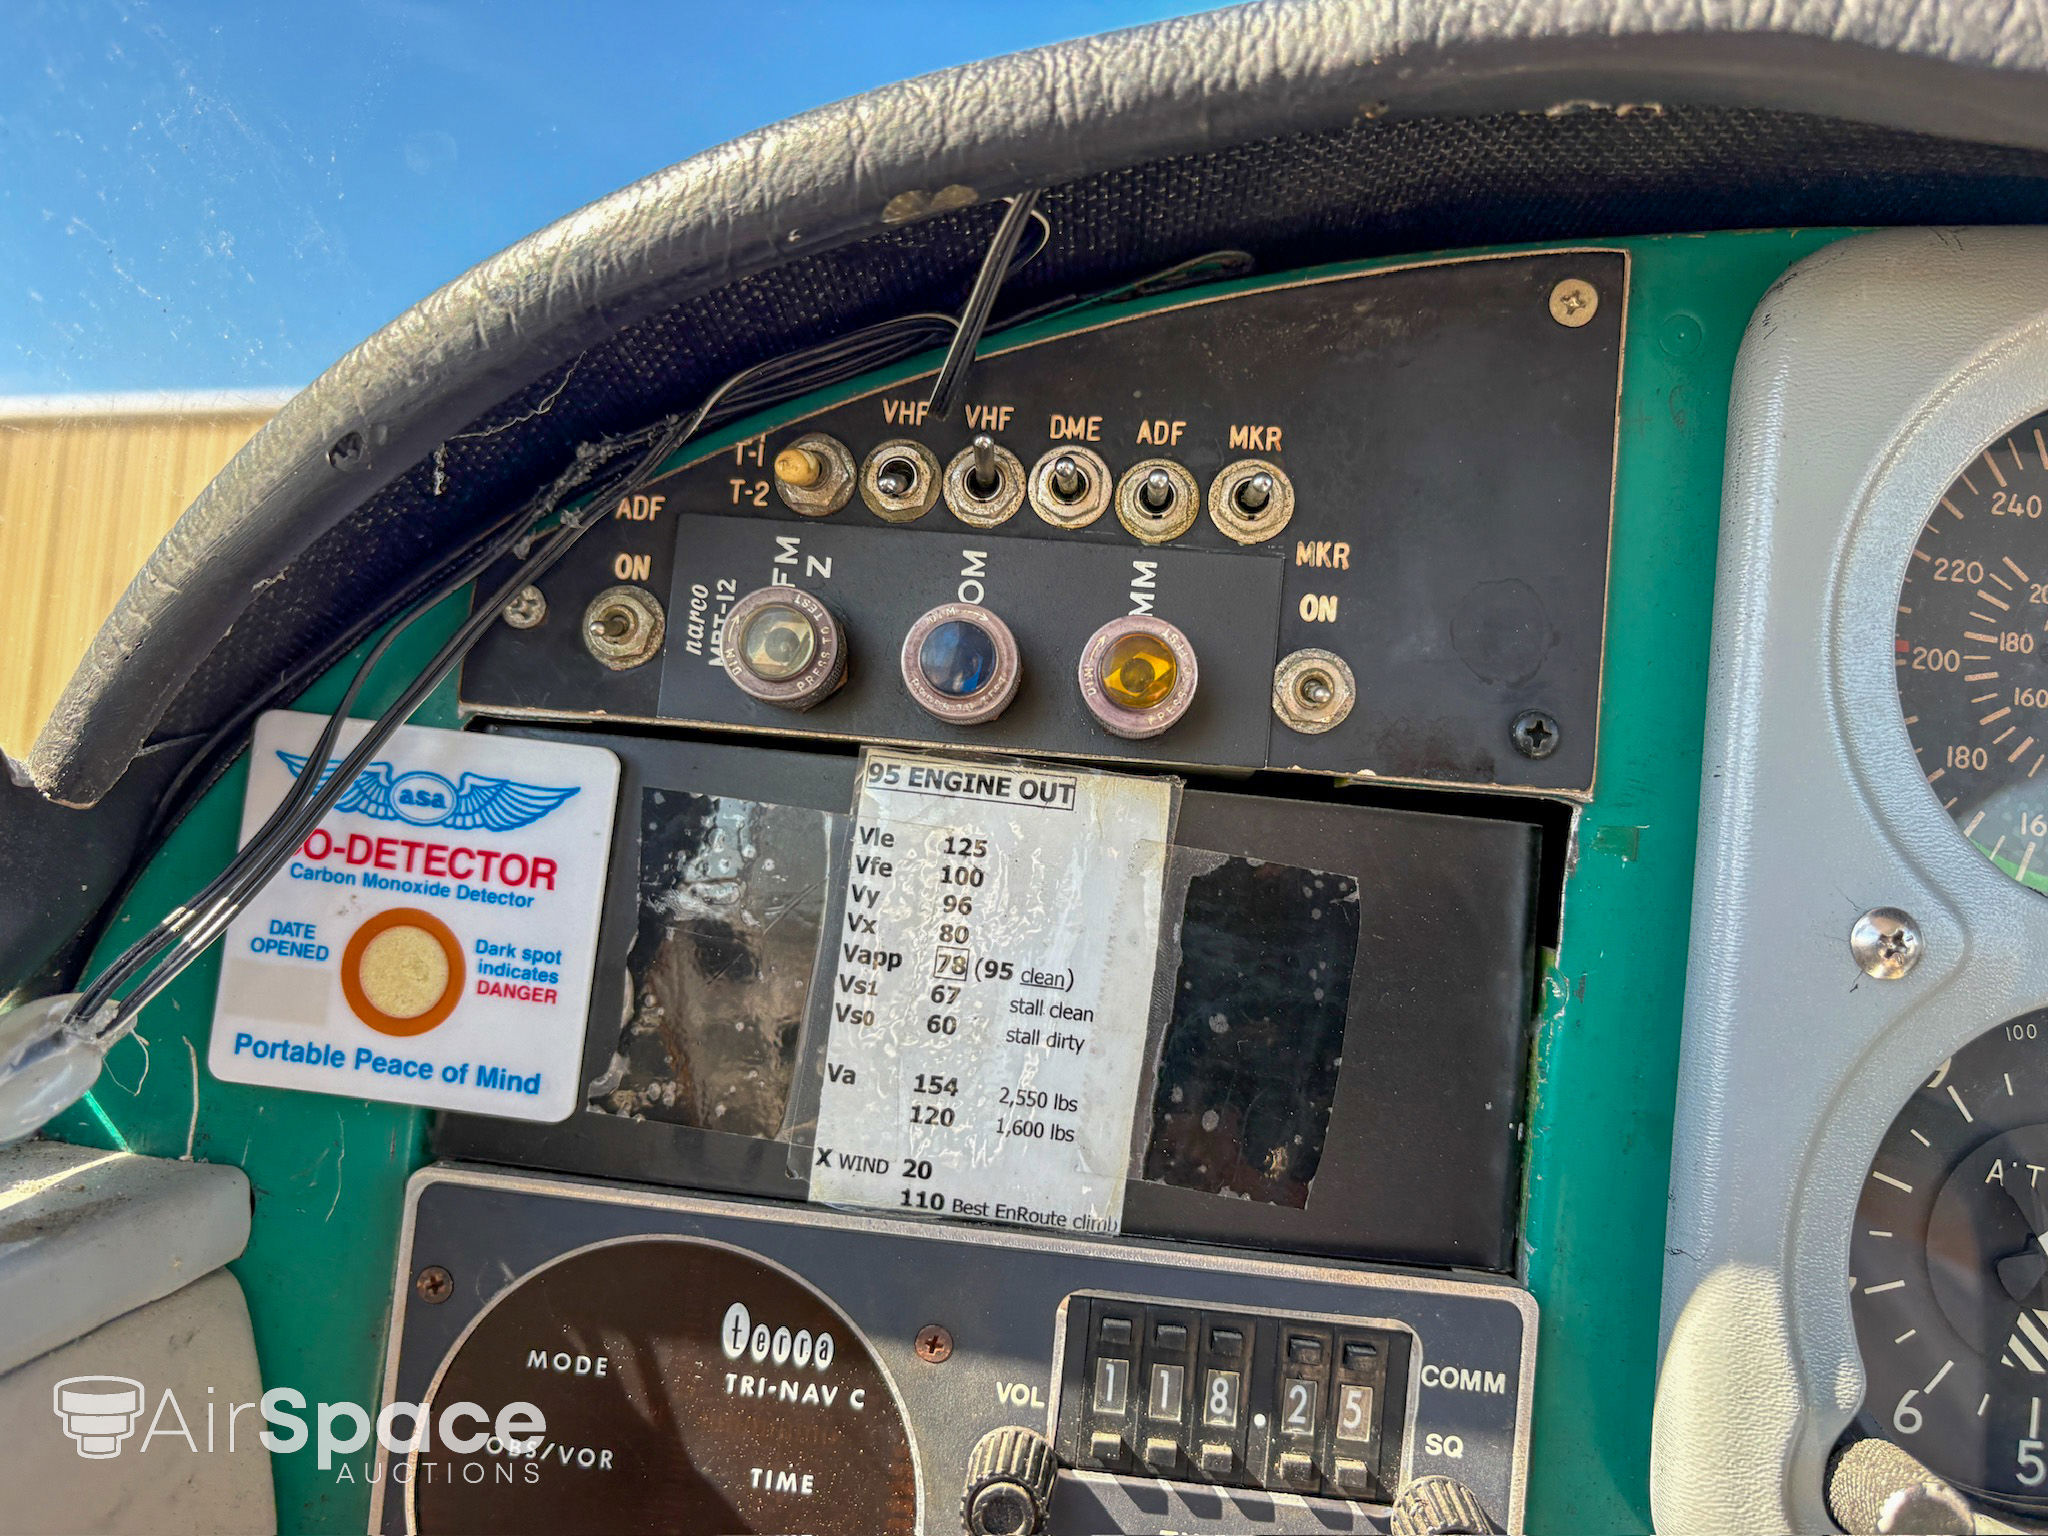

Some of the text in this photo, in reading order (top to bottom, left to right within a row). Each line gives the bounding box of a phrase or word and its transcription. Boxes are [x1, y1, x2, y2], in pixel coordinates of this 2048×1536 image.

[882, 399, 930, 425] VHF
[965, 404, 1014, 431] VHF
[1049, 414, 1103, 441] DME
[1136, 420, 1186, 446] ADF
[1229, 425, 1282, 451] MKR
[730, 479, 769, 507] T-2
[1991, 491, 2042, 519] 240
[615, 496, 666, 521] ADF
[614, 554, 651, 581] ON
[772, 536, 800, 587] FM
[1295, 541, 1350, 570] MKR
[958, 550, 987, 604] OM
[1934, 558, 1984, 584] 220
[1129, 561, 1158, 616] MM
[686, 584, 709, 655] narco
[793, 594, 824, 622] TEST
[1300, 594, 1338, 623] ON
[1999, 632, 2034, 653] 180
[1912, 647, 1960, 672] 200
[2014, 687, 2048, 708] 160
[1946, 745, 1988, 771] 180
[399, 786, 448, 809] asa
[868, 762, 1075, 805] 95 ENGINE OUT
[859, 826, 988, 858] Vle 125
[293, 829, 558, 890] O-DETECTOR
[855, 855, 984, 888] Vfe 100
[289, 862, 535, 909] Carbon Monoxide Detector
[851, 884, 972, 916] Vy 96
[269, 920, 316, 940] DATE
[847, 911, 970, 944] Vx 80
[250, 938, 329, 961] OPENED
[475, 939, 562, 966] Dark spot
[478, 959, 559, 984] indicates
[844, 943, 1074, 992] Vapp 78 (95 clean)
[476, 980, 558, 1004] DANGER
[840, 974, 1094, 1023] Vs1 67 stall clean
[926, 1014, 958, 1035] 60
[1006, 1028, 1040, 1047] stall
[1046, 1031, 1085, 1053] dirty
[2005, 1023, 2038, 1041] 100
[234, 1033, 541, 1095] Portable Peace of Mind
[827, 1063, 1079, 1112] Va 154 2,550 lbs
[910, 1105, 1075, 1143] 120 1,600 lbs
[815, 1147, 933, 1180] X WIND 20
[900, 1190, 1118, 1231] 110 Best EnRoute climb
[731, 1313, 830, 1361] terra
[527, 1349, 609, 1378] MODE
[724, 1372, 867, 1409] TRI-NAV C
[1421, 1364, 1507, 1394] COMM
[996, 1381, 1045, 1408] VOL
[1893, 1389, 1923, 1435] 6
[486, 1435, 614, 1471] OBS/VOR
[1425, 1432, 1464, 1459] SQ
[2016, 1440, 2045, 1486] 5
[750, 1467, 815, 1496] TIME
